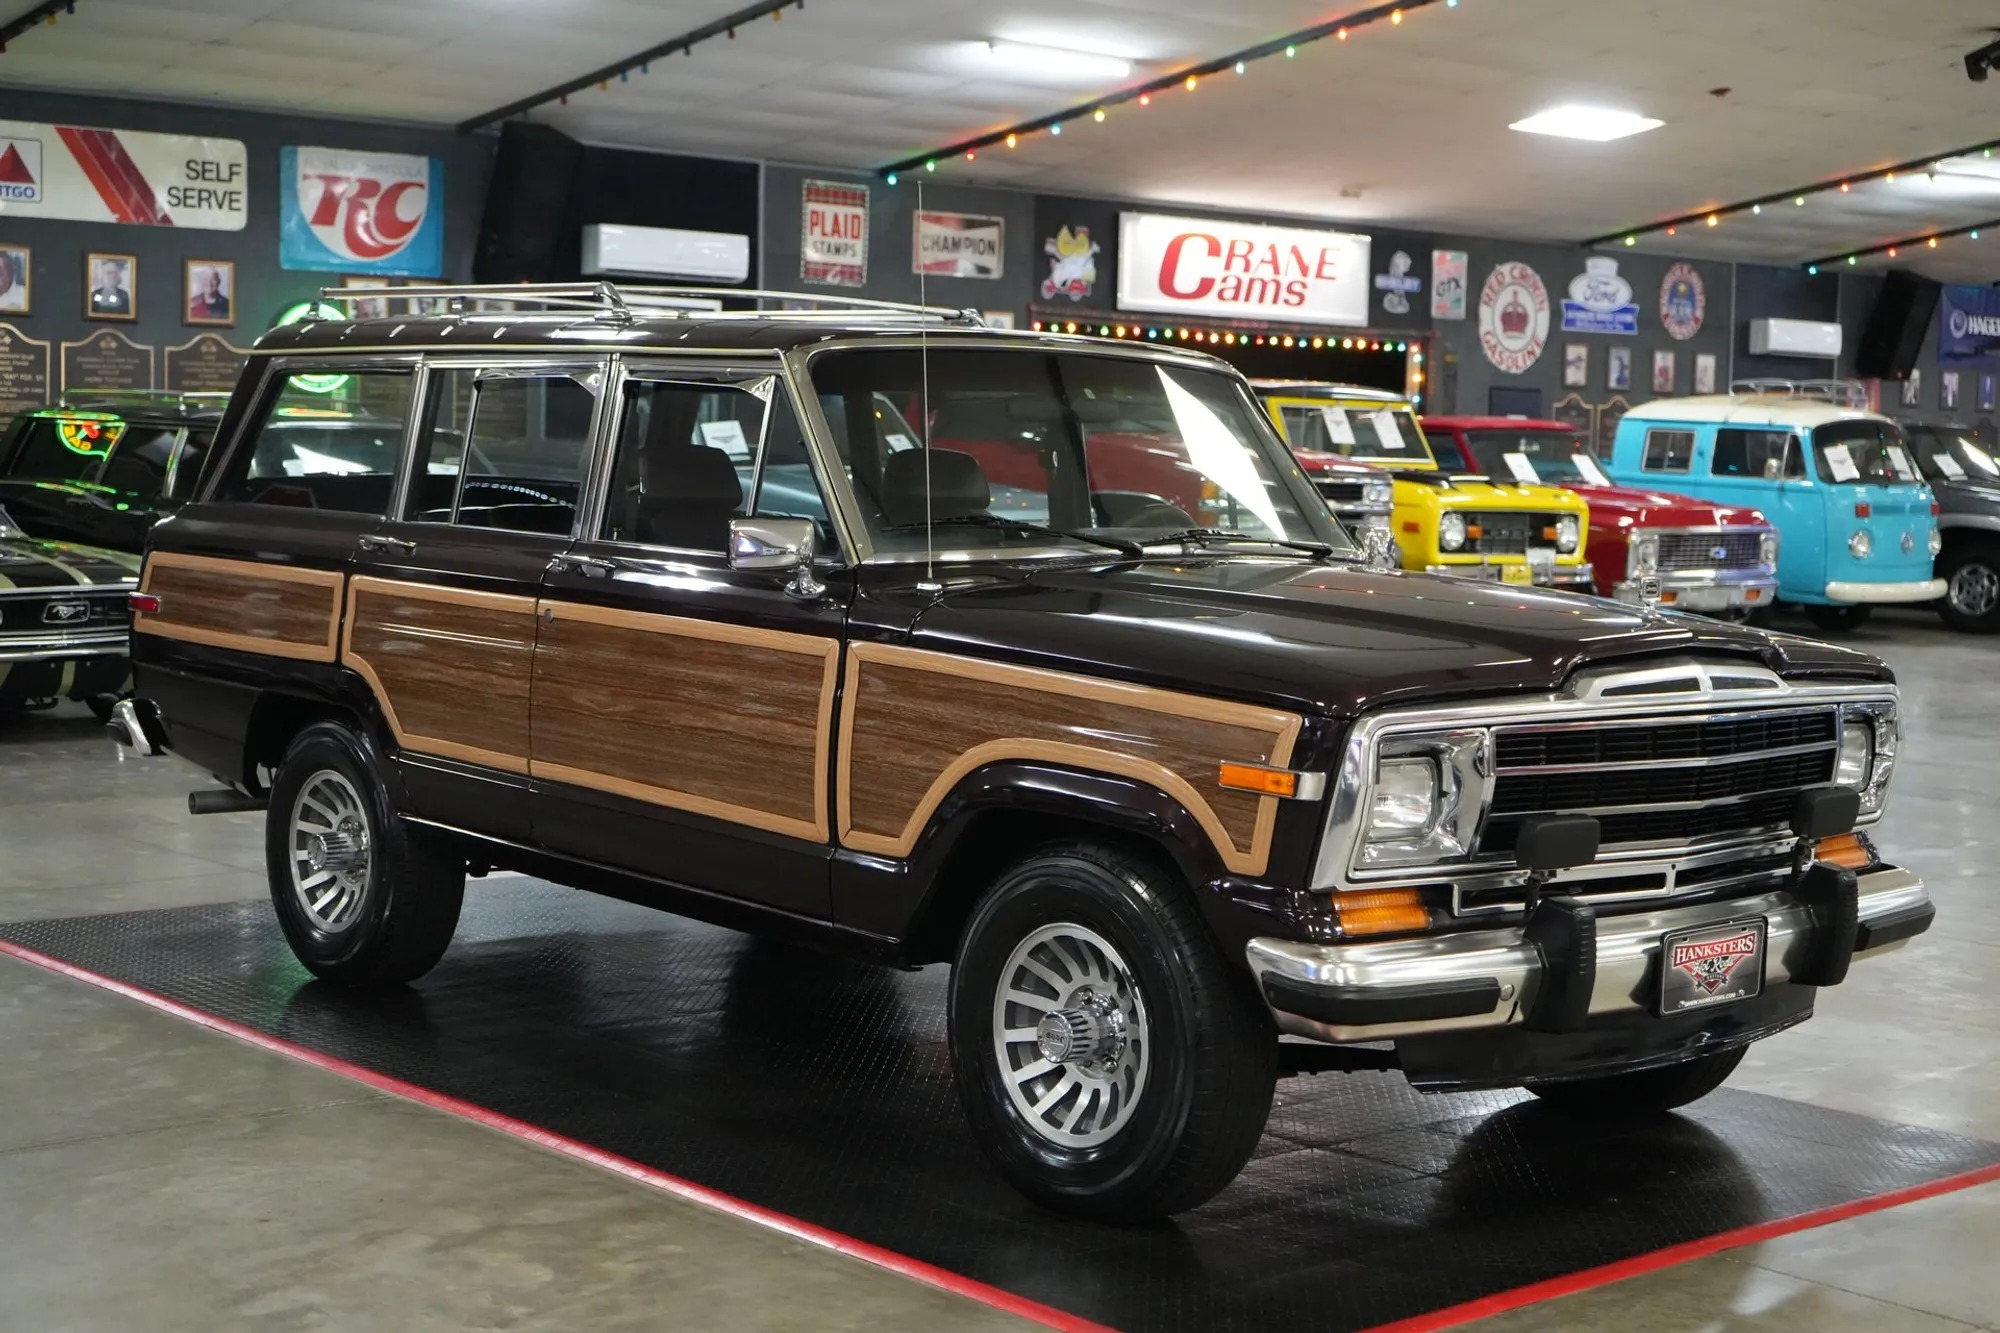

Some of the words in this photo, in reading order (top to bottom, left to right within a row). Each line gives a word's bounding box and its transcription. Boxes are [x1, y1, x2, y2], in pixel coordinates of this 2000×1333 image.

[186, 159, 242, 183] SELF
[167, 186, 242, 211] SERVE
[302, 173, 426, 258] RC
[809, 210, 861, 239] PLAID
[812, 240, 857, 257] STAMPS
[921, 231, 996, 257] CHAMPION
[1158, 233, 1341, 300] CRANE
[1436, 278, 1462, 297] GTX
[1583, 279, 1620, 304] Ford
[1483, 330, 1545, 373] GASOLINE
[1676, 936, 1754, 964] HANKSTERS
